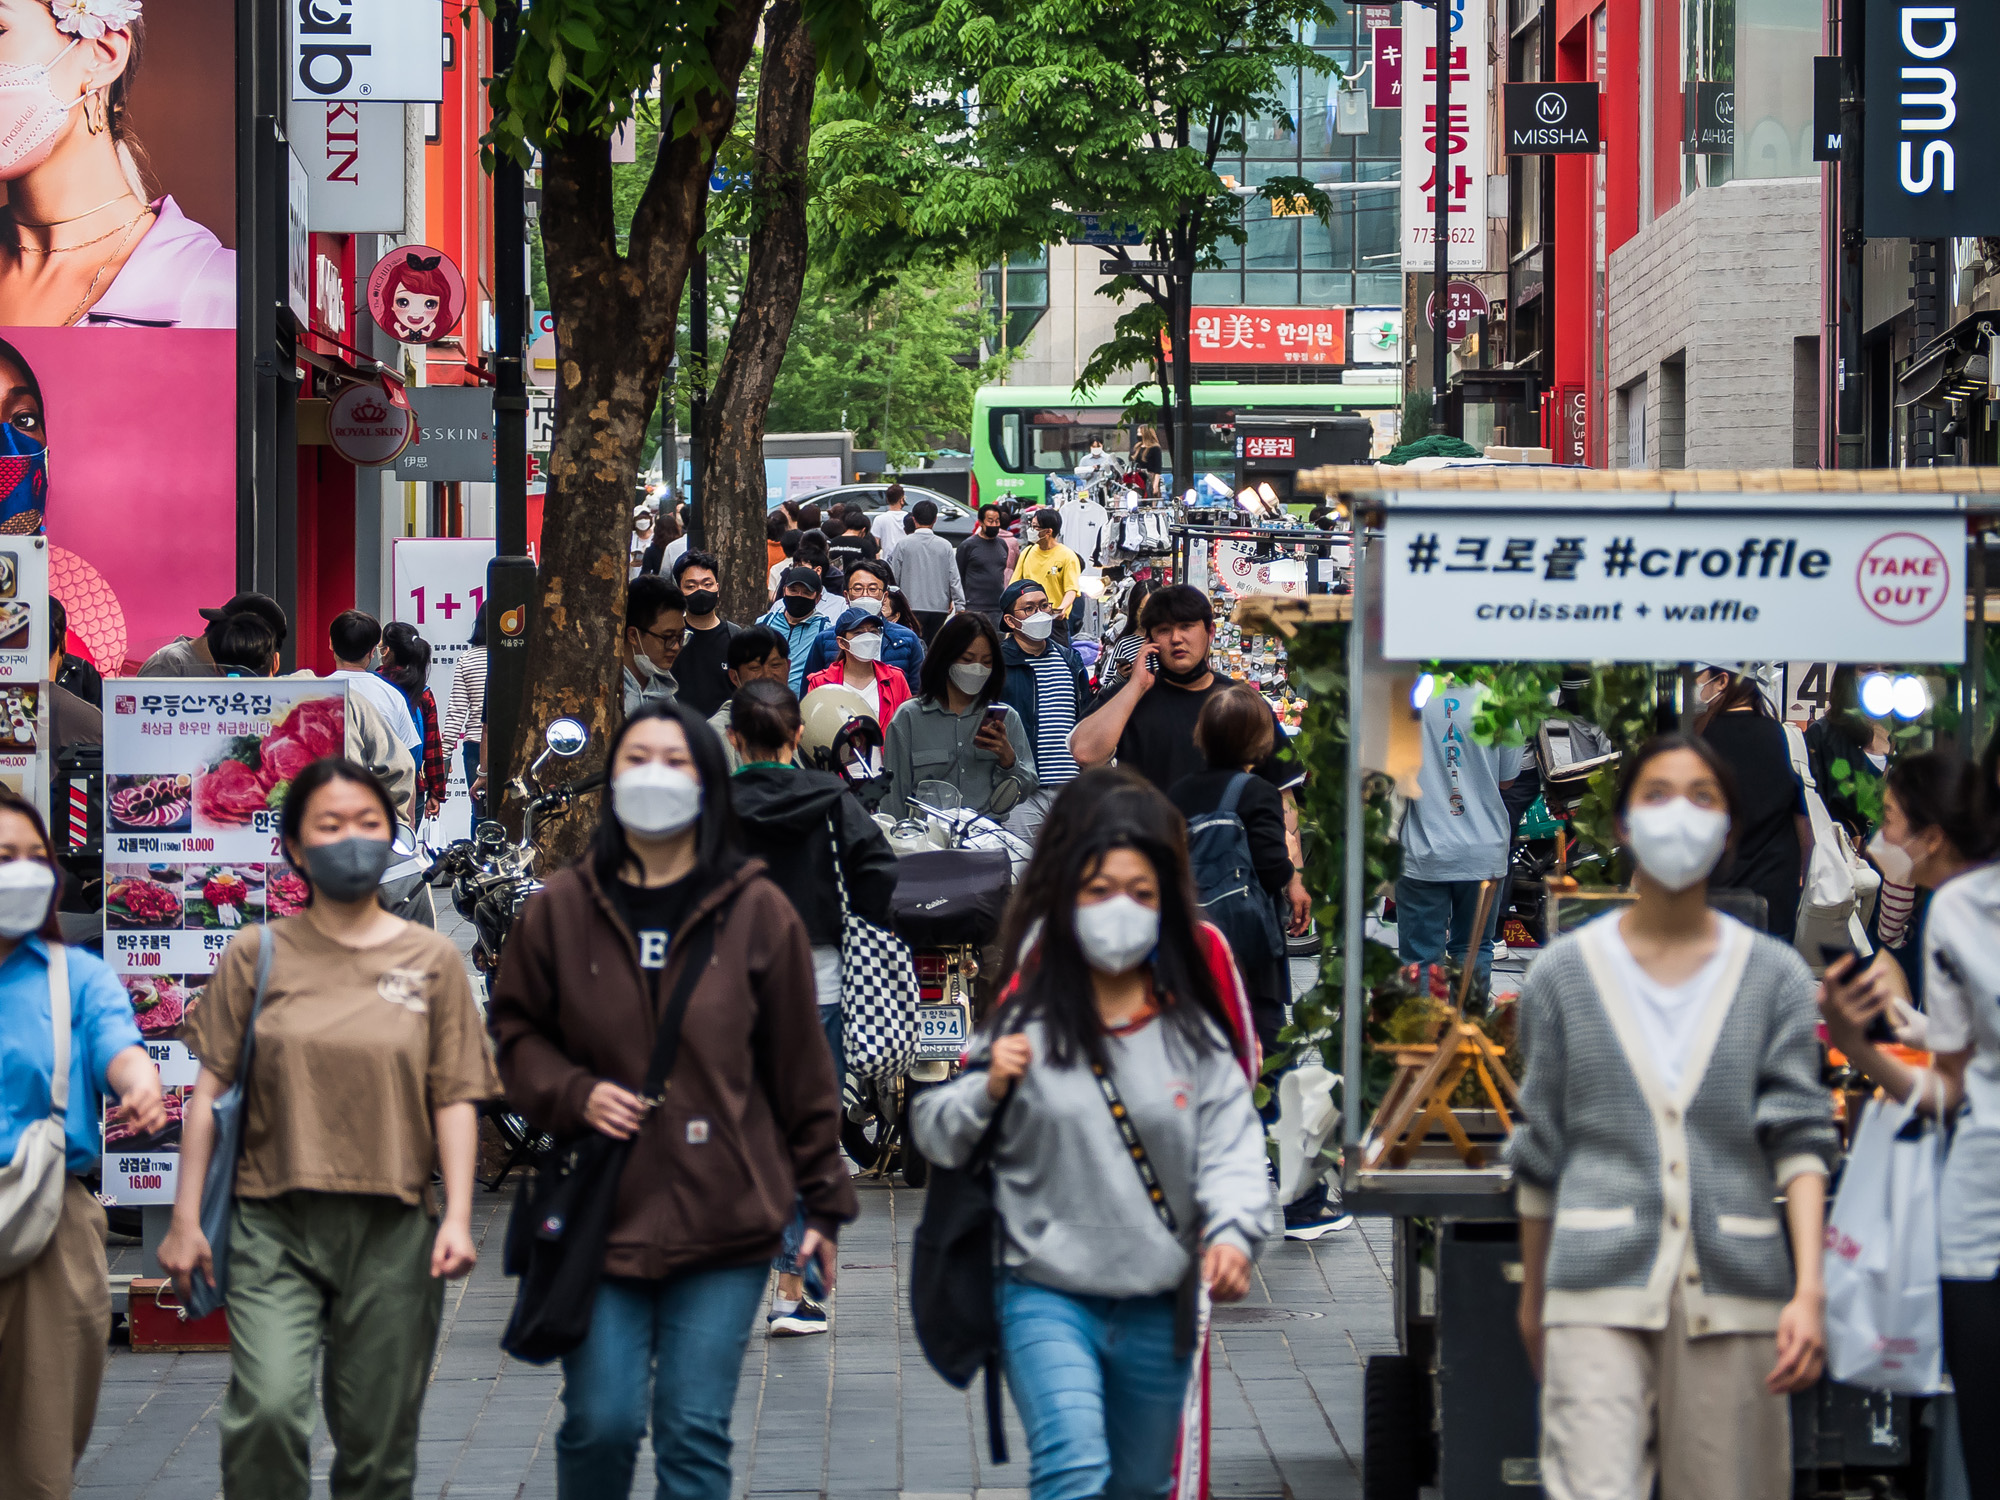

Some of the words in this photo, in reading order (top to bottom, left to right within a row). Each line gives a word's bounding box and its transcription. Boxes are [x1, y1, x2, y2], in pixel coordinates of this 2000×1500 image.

[1, 104, 38, 148] masklab
[1514, 128, 1589, 145] MISSHA
[1276, 322, 1333, 346] 한의원
[335, 427, 372, 437] ROYAL
[374, 427, 403, 437] SKIN
[1247, 438, 1293, 457] 상품권
[403, 456, 428, 468] 伊思
[1408, 533, 1587, 580] #크로플
[1604, 537, 1832, 579] #croffle
[1866, 556, 1938, 577] TAKE
[1873, 587, 1931, 606] OUT
[410, 586, 484, 625] 1+1
[1476, 599, 1623, 621] croissant
[1664, 599, 1758, 621] waffle
[140, 692, 272, 717] 무등산정육점
[140, 721, 173, 735] 최상급
[178, 721, 211, 735] 한우만
[216, 721, 271, 735] 취급합니다
[181, 838, 215, 852] 19,000
[117, 934, 138, 950] 한우
[139, 934, 171, 950] 주물럭
[203, 934, 225, 950] 한우
[127, 952, 161, 967] 21,000
[919, 1020, 959, 1036] 894
[146, 1046, 171, 1061] 마살
[921, 1044, 963, 1053] ONSTER
[119, 1157, 151, 1173] 삼겹살
[128, 1174, 162, 1190] 16,000
